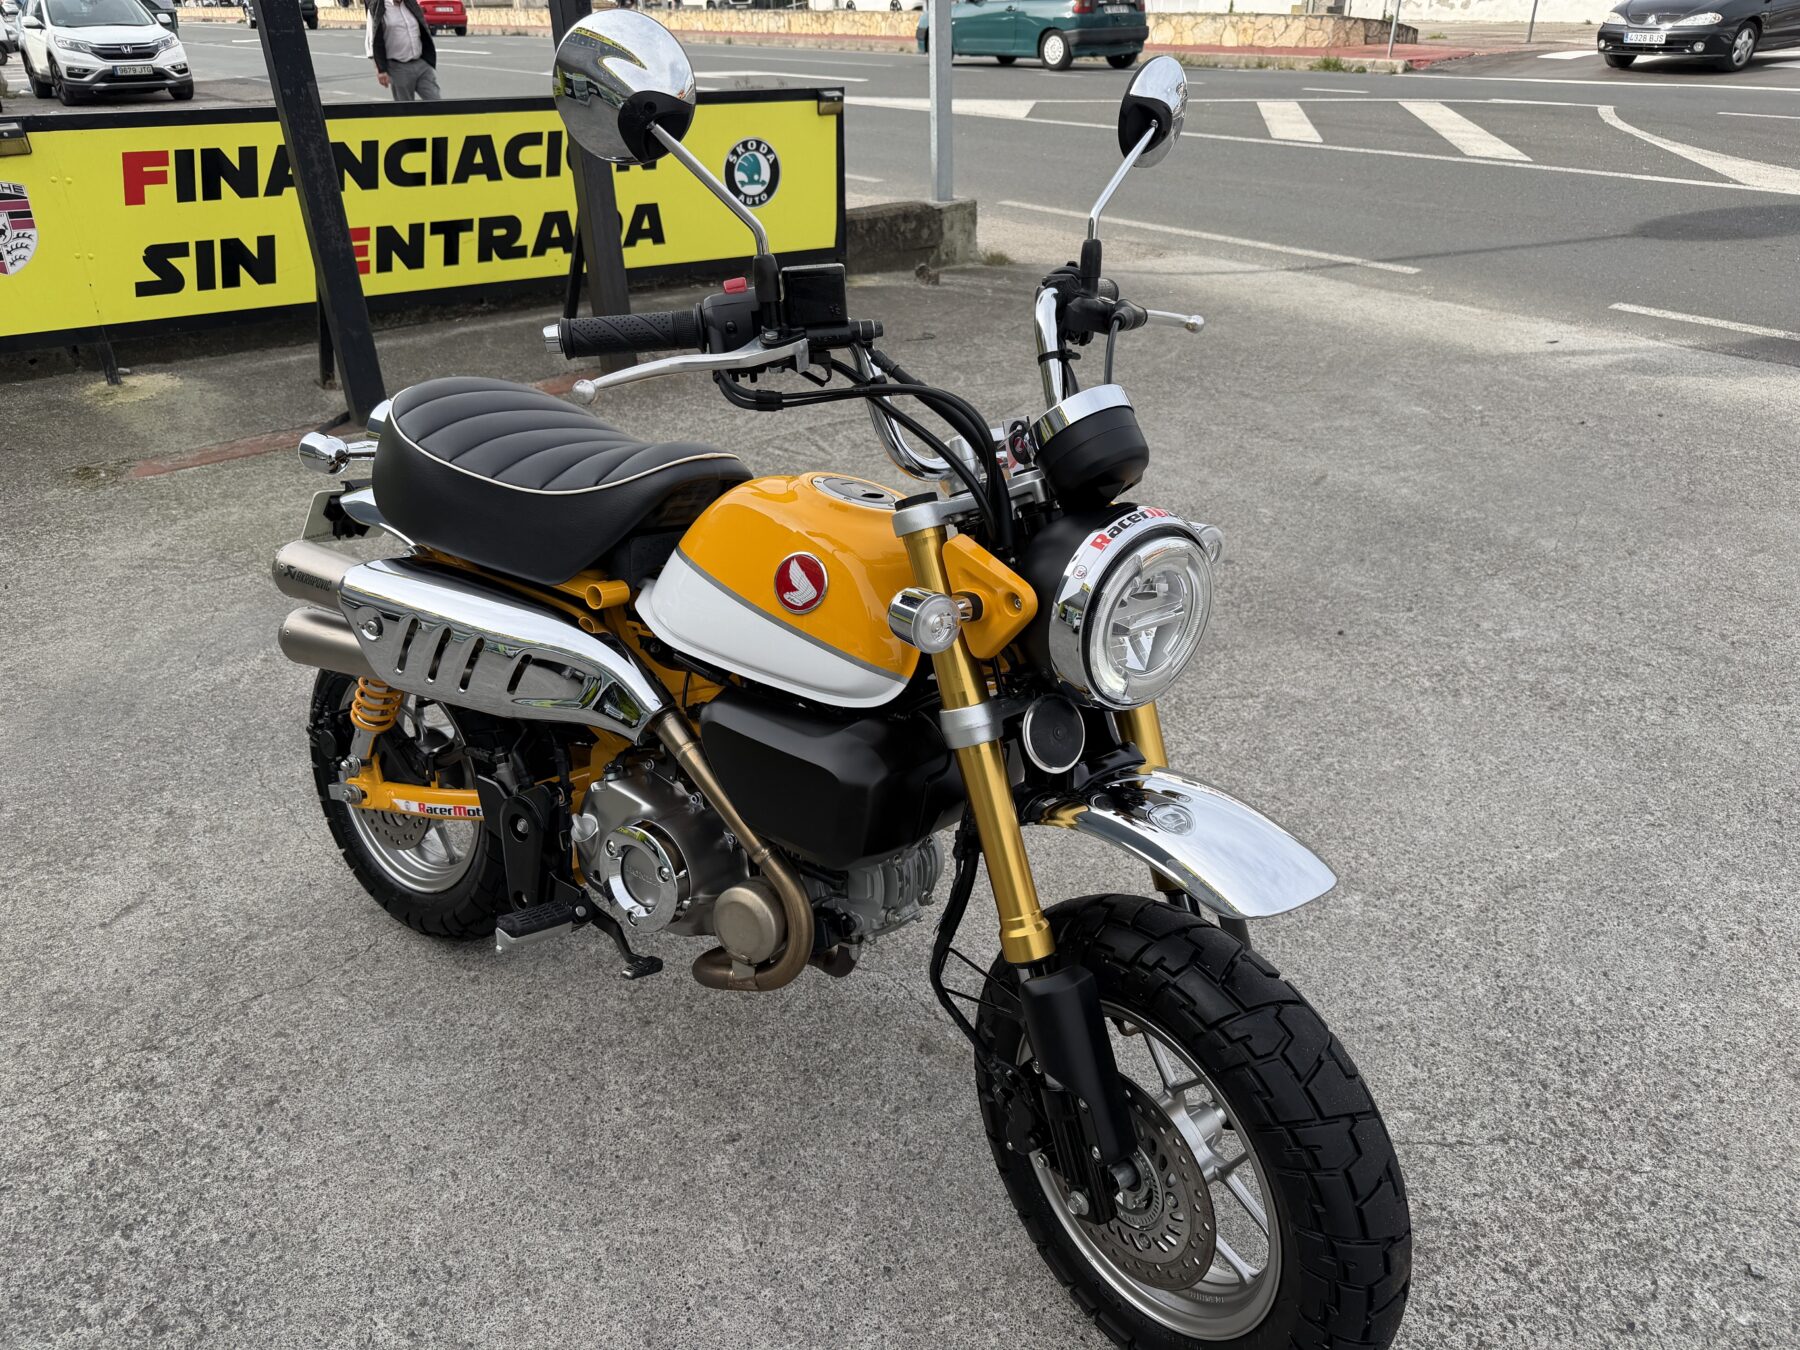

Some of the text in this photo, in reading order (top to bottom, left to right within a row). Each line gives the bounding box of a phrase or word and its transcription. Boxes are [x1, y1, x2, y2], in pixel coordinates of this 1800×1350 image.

[122, 130, 657, 206] FINANCIACI
[738, 193, 768, 205] AUTO
[135, 203, 666, 298] SIN NTRAA
